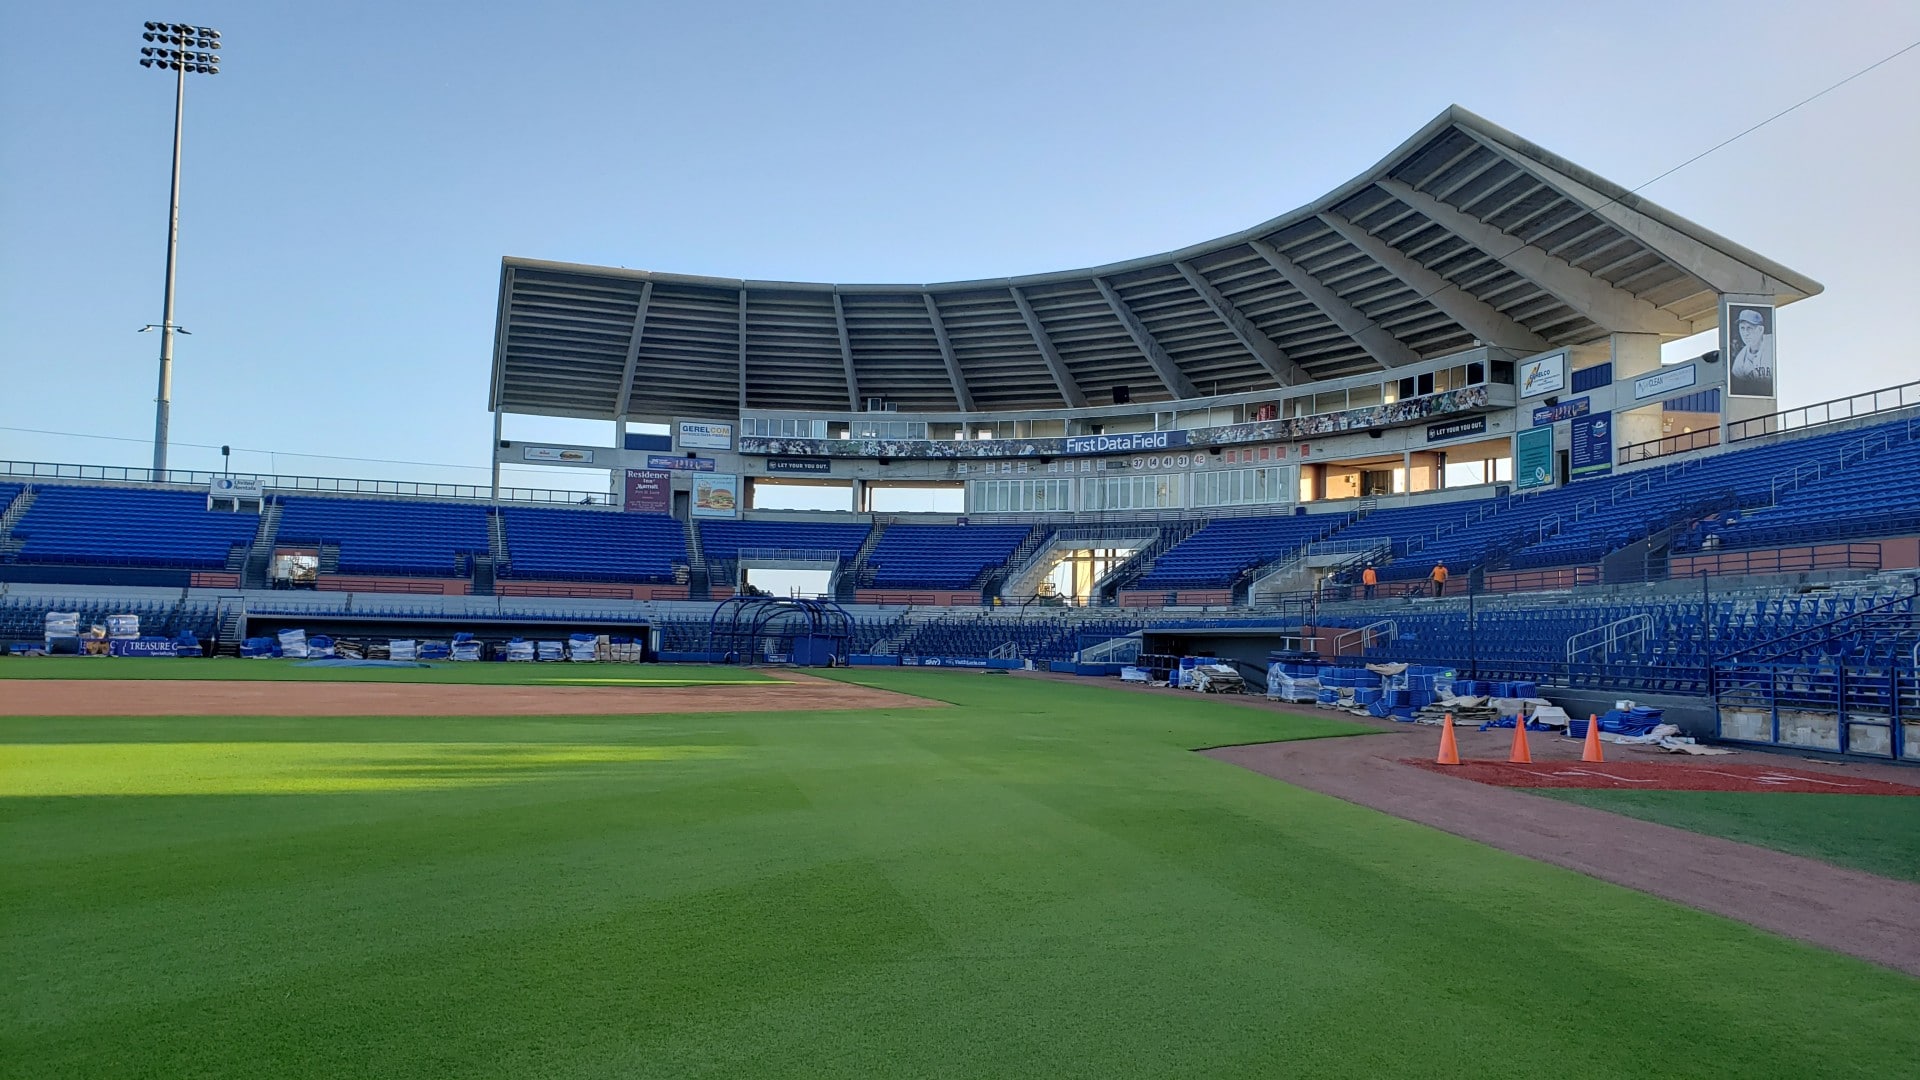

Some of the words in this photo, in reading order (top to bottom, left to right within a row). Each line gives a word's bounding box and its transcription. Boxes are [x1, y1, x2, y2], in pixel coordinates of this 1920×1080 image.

[1436, 428, 1446, 436] LET
[1460, 423, 1471, 431] YOU
[1066, 438, 1096, 453] First
[1098, 436, 1131, 451] Data
[1132, 432, 1168, 448] Field
[627, 470, 669, 479] Residence
[130, 641, 170, 651] TREASURE
